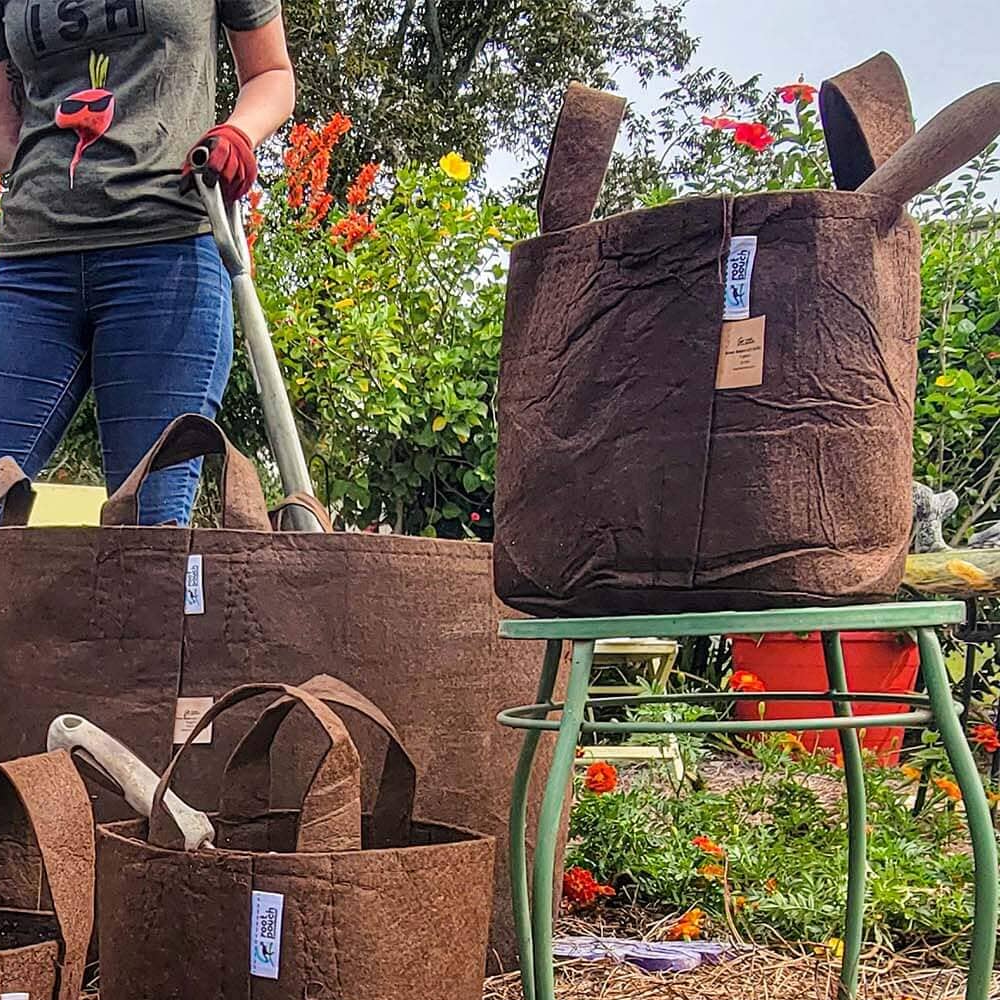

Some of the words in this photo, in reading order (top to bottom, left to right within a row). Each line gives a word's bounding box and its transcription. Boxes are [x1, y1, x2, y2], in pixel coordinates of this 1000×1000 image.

[730, 258, 739, 280] root
[737, 250, 747, 280] pouch
[265, 907, 275, 939] pouch
